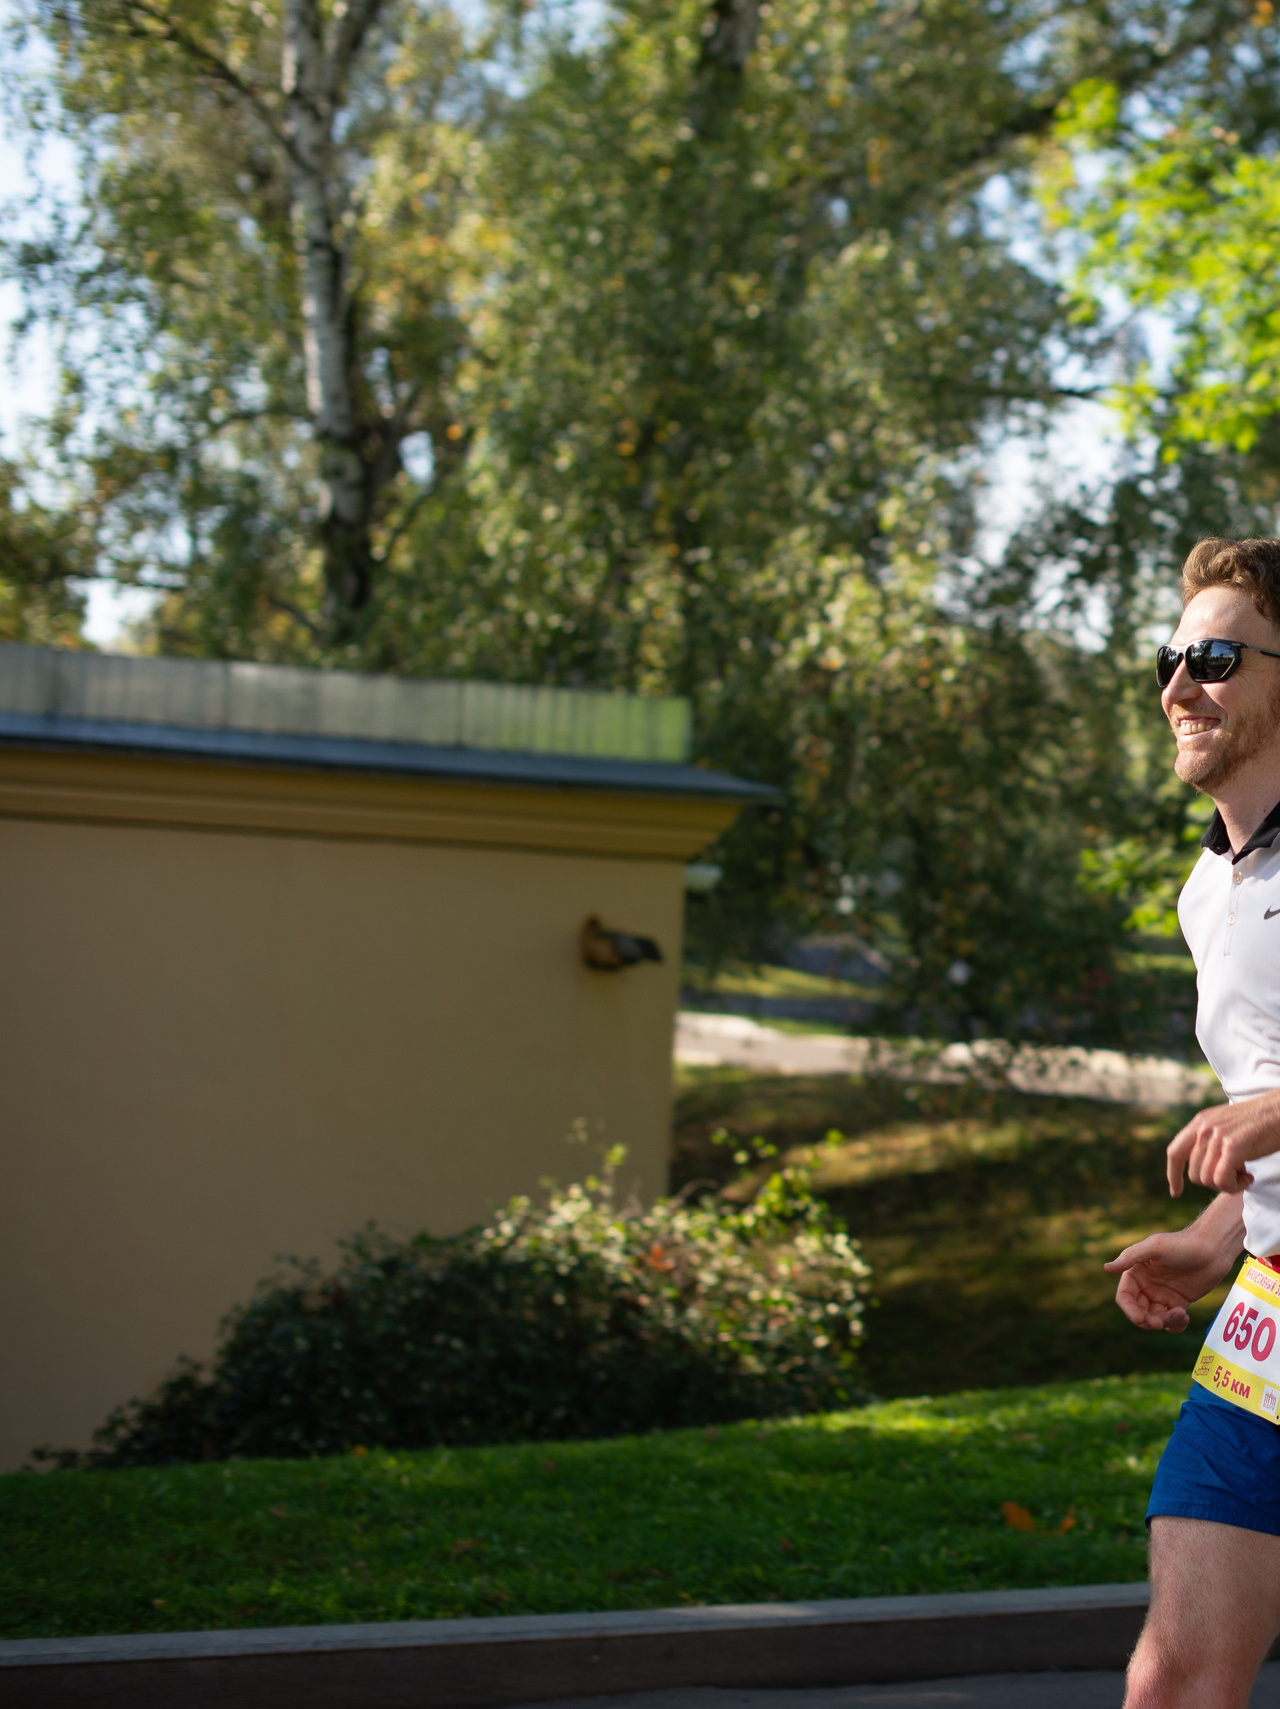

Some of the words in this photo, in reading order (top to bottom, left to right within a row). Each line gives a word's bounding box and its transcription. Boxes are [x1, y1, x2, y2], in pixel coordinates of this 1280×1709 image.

[1223, 1301, 1277, 1362] 650
[1213, 1365, 1232, 1388] 5,5
[1231, 1379, 1251, 1399] КМ
